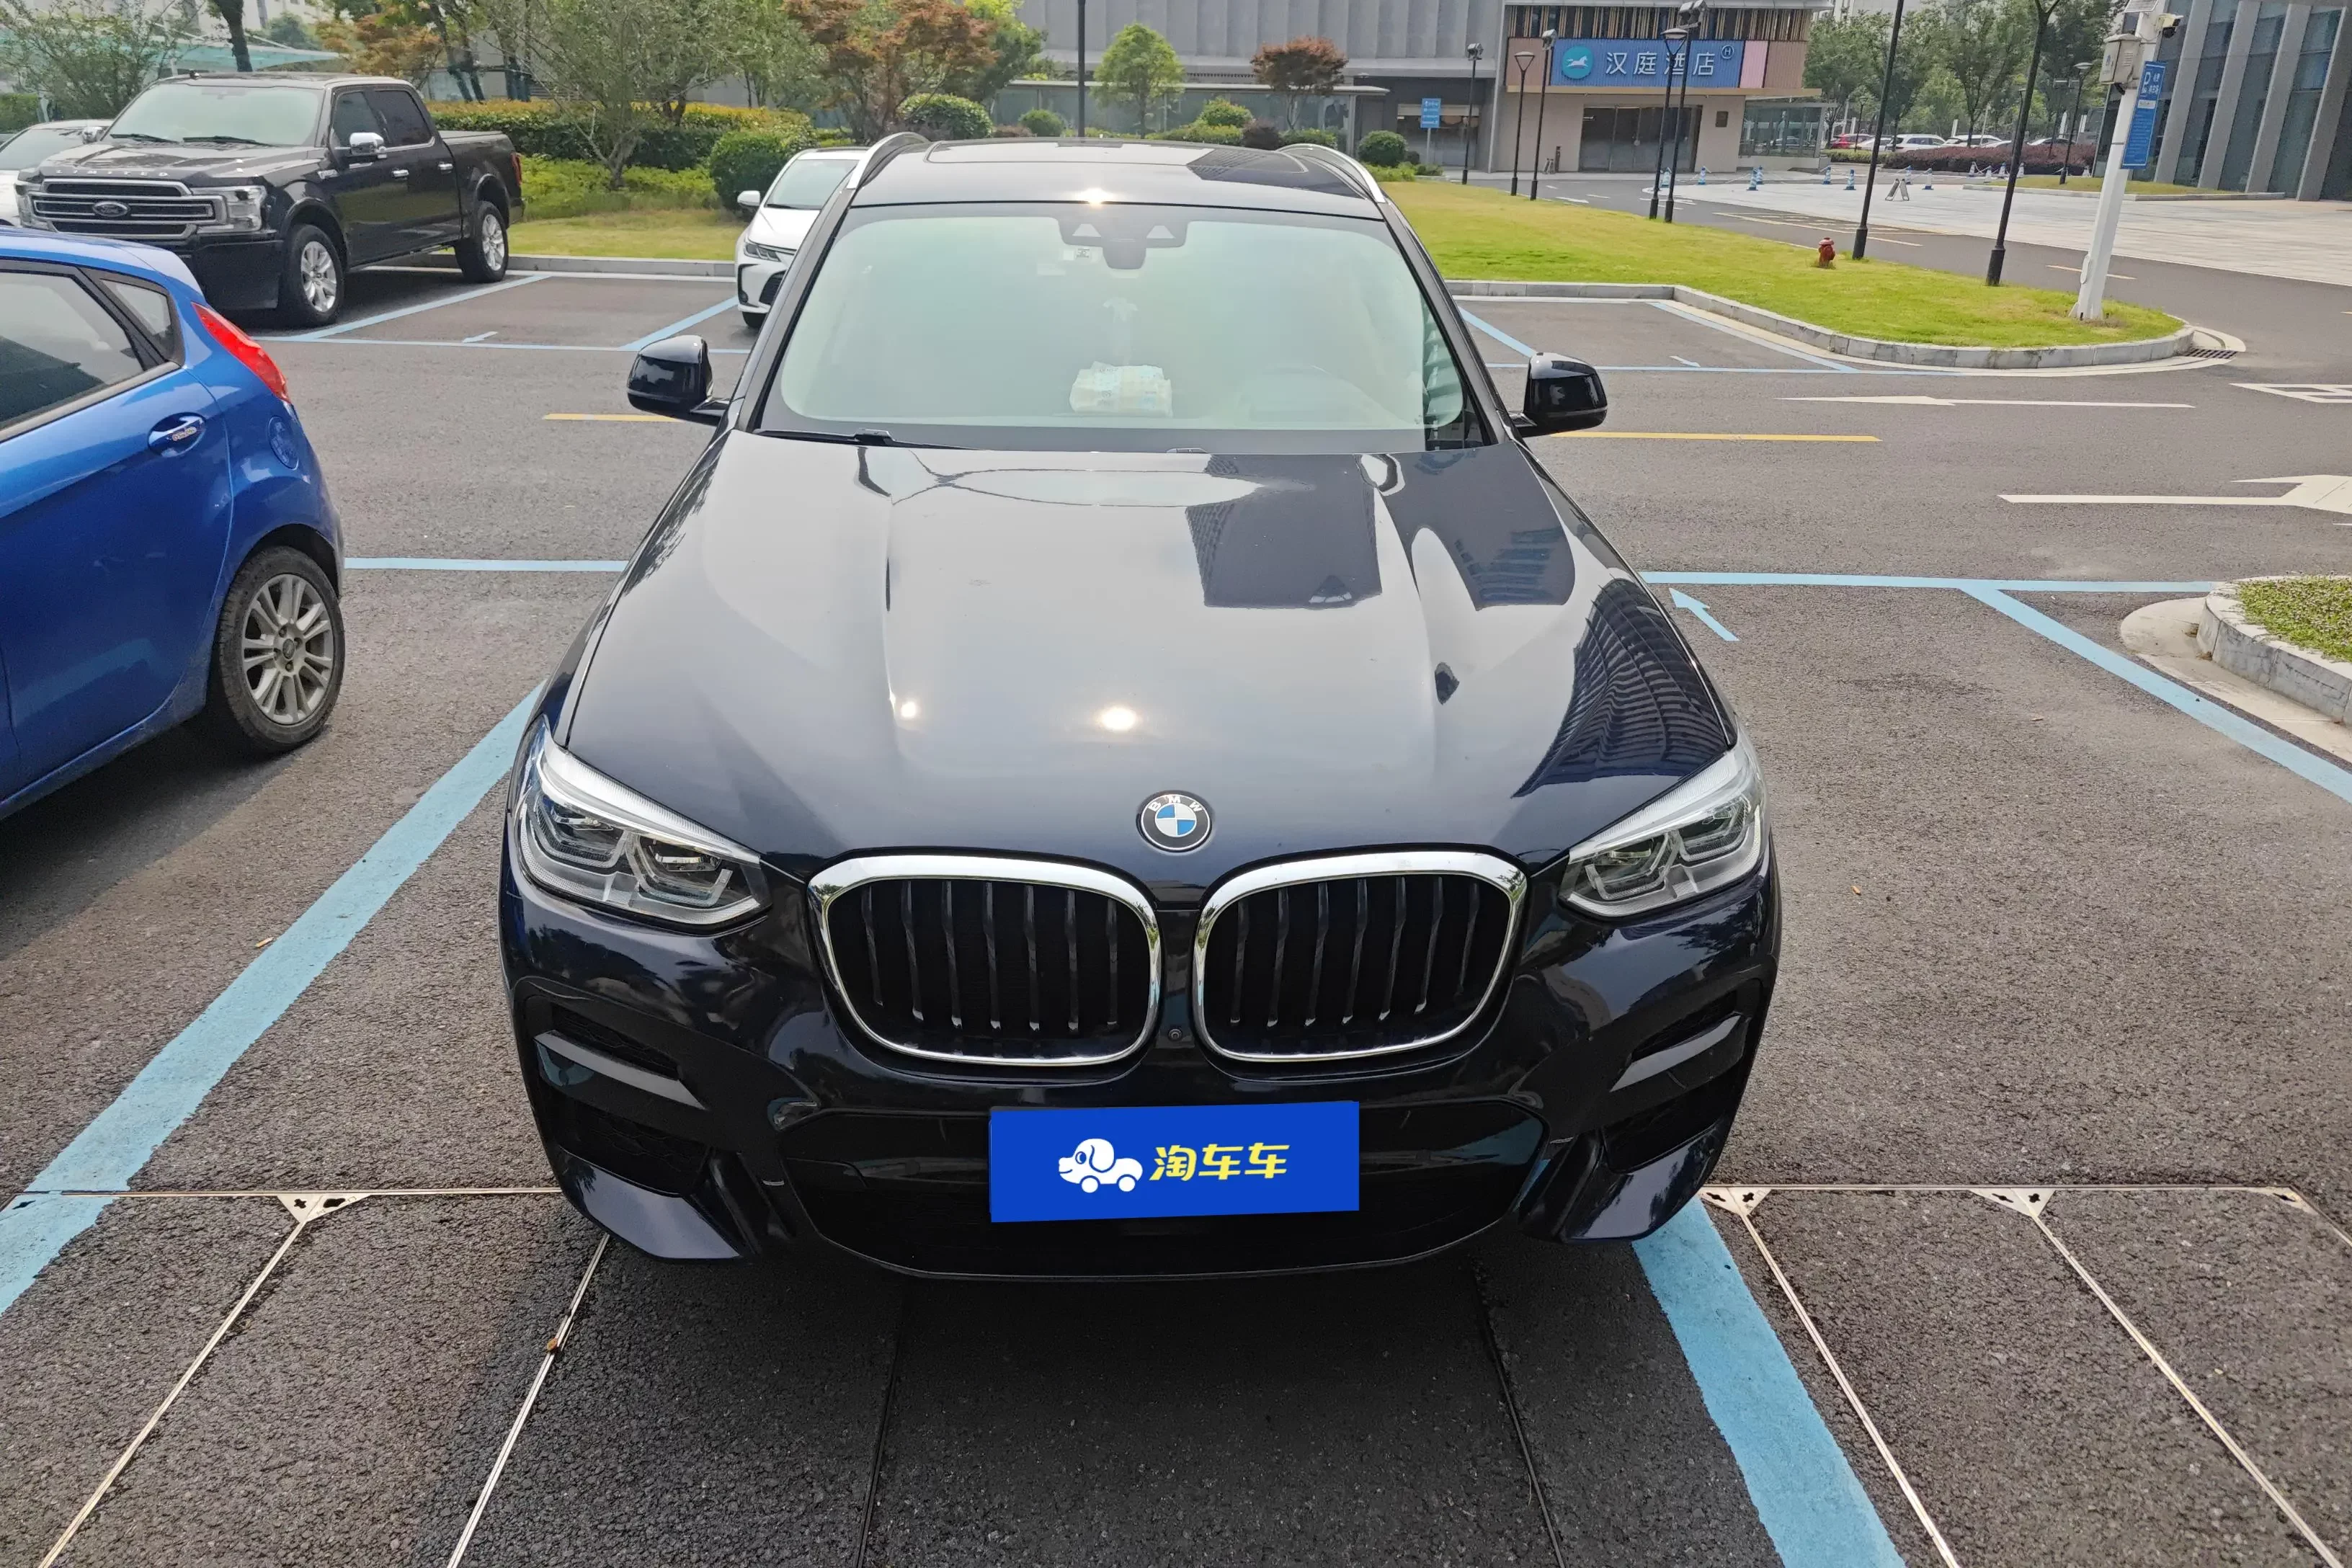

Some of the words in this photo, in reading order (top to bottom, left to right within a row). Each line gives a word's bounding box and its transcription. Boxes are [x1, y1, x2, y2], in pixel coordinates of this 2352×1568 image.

[1605, 51, 1715, 76] 汉庭酒店
[1147, 795, 1203, 812] BMW
